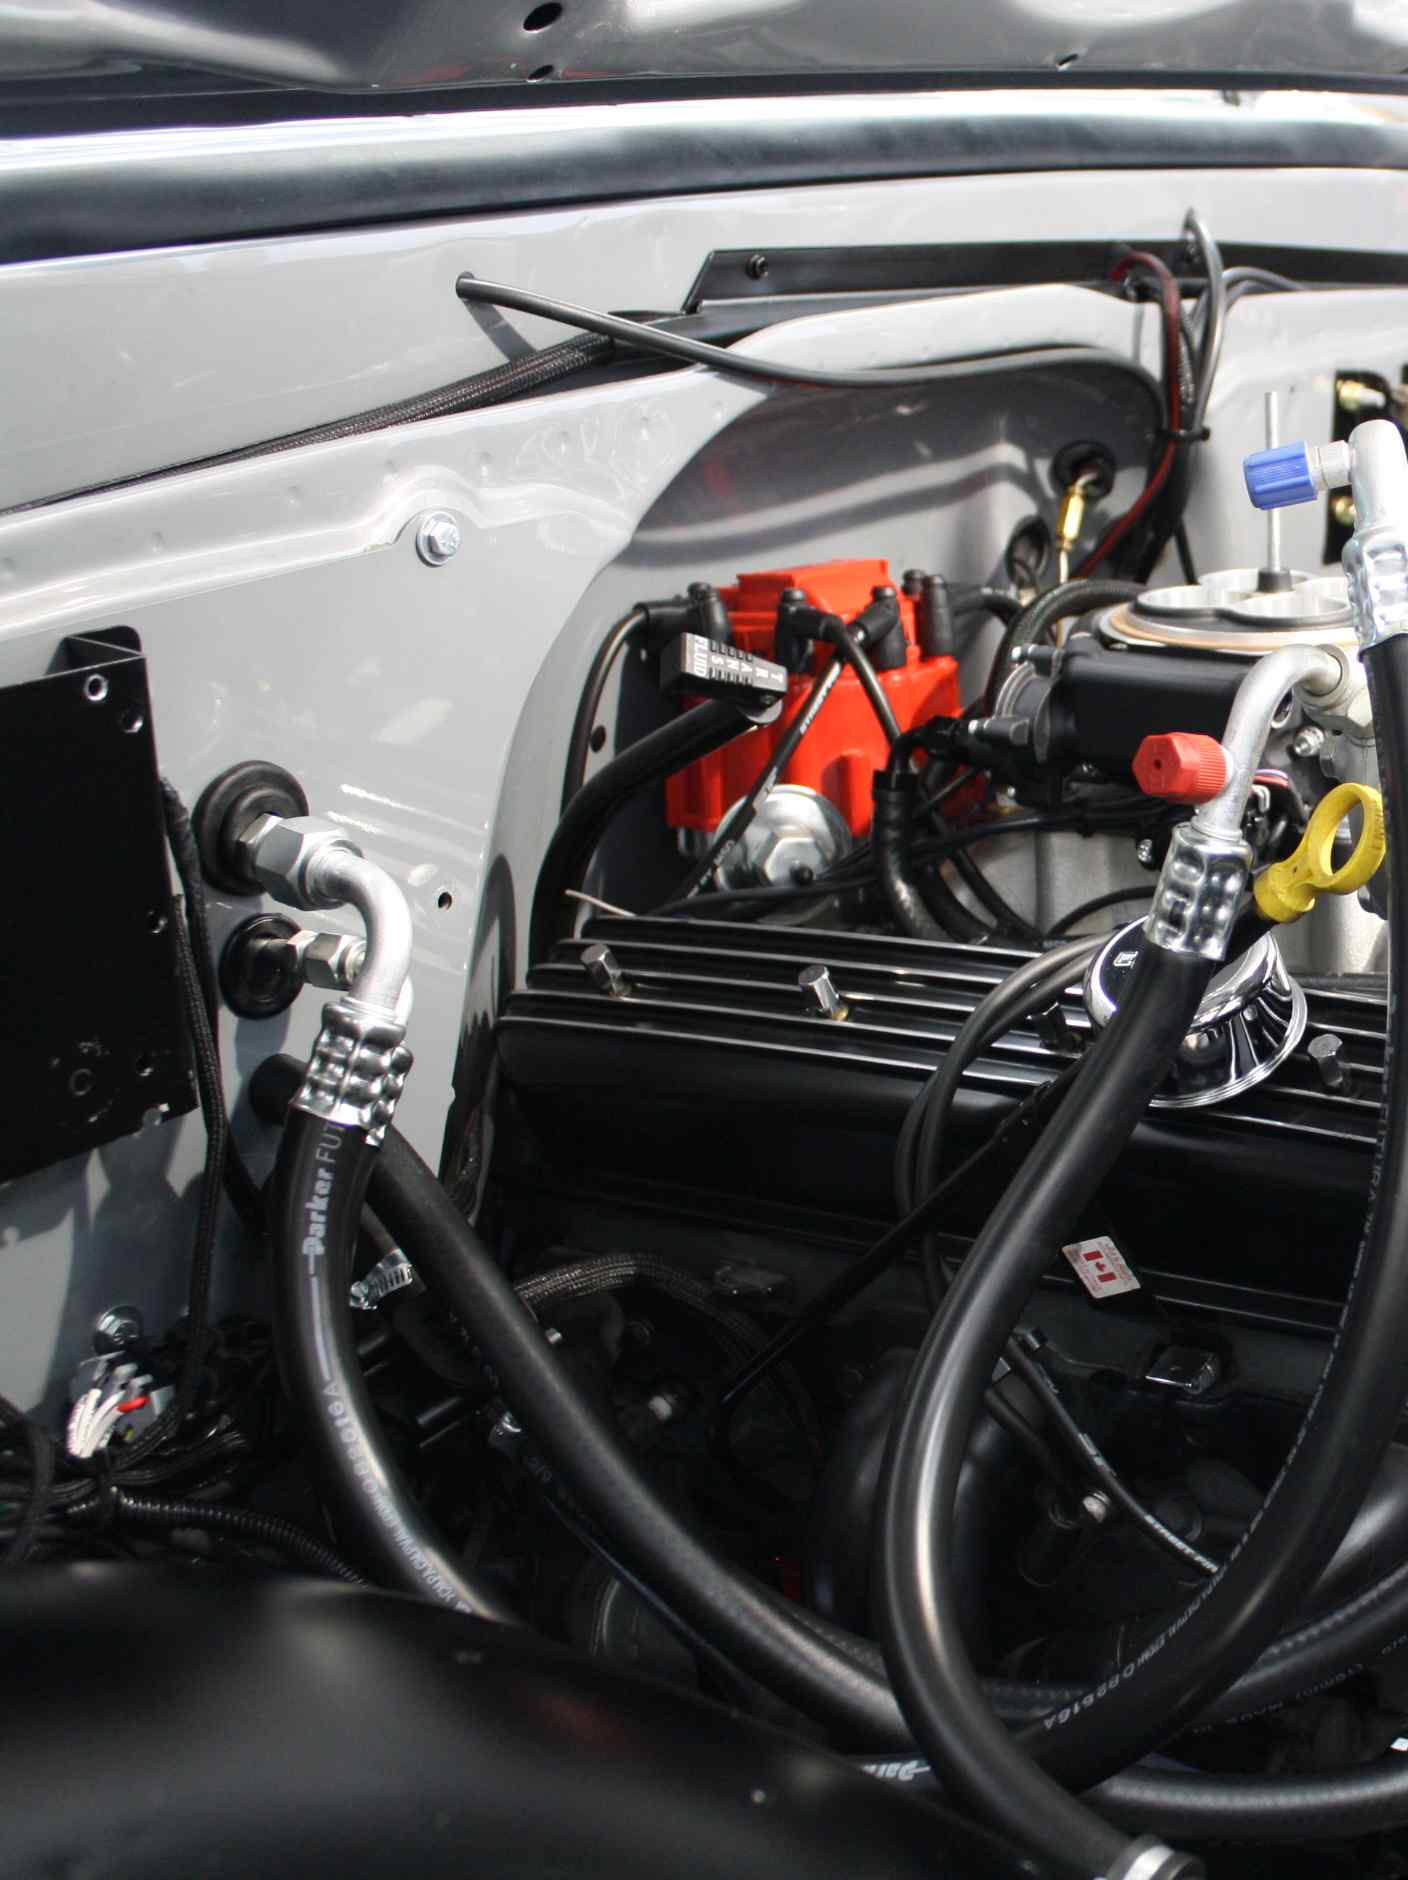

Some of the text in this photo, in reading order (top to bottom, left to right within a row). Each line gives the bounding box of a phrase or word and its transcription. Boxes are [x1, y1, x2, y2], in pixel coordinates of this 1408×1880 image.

[693, 635, 709, 678] FLUID
[711, 654, 785, 685] TRANS
[302, 1165, 336, 1257] Parker
